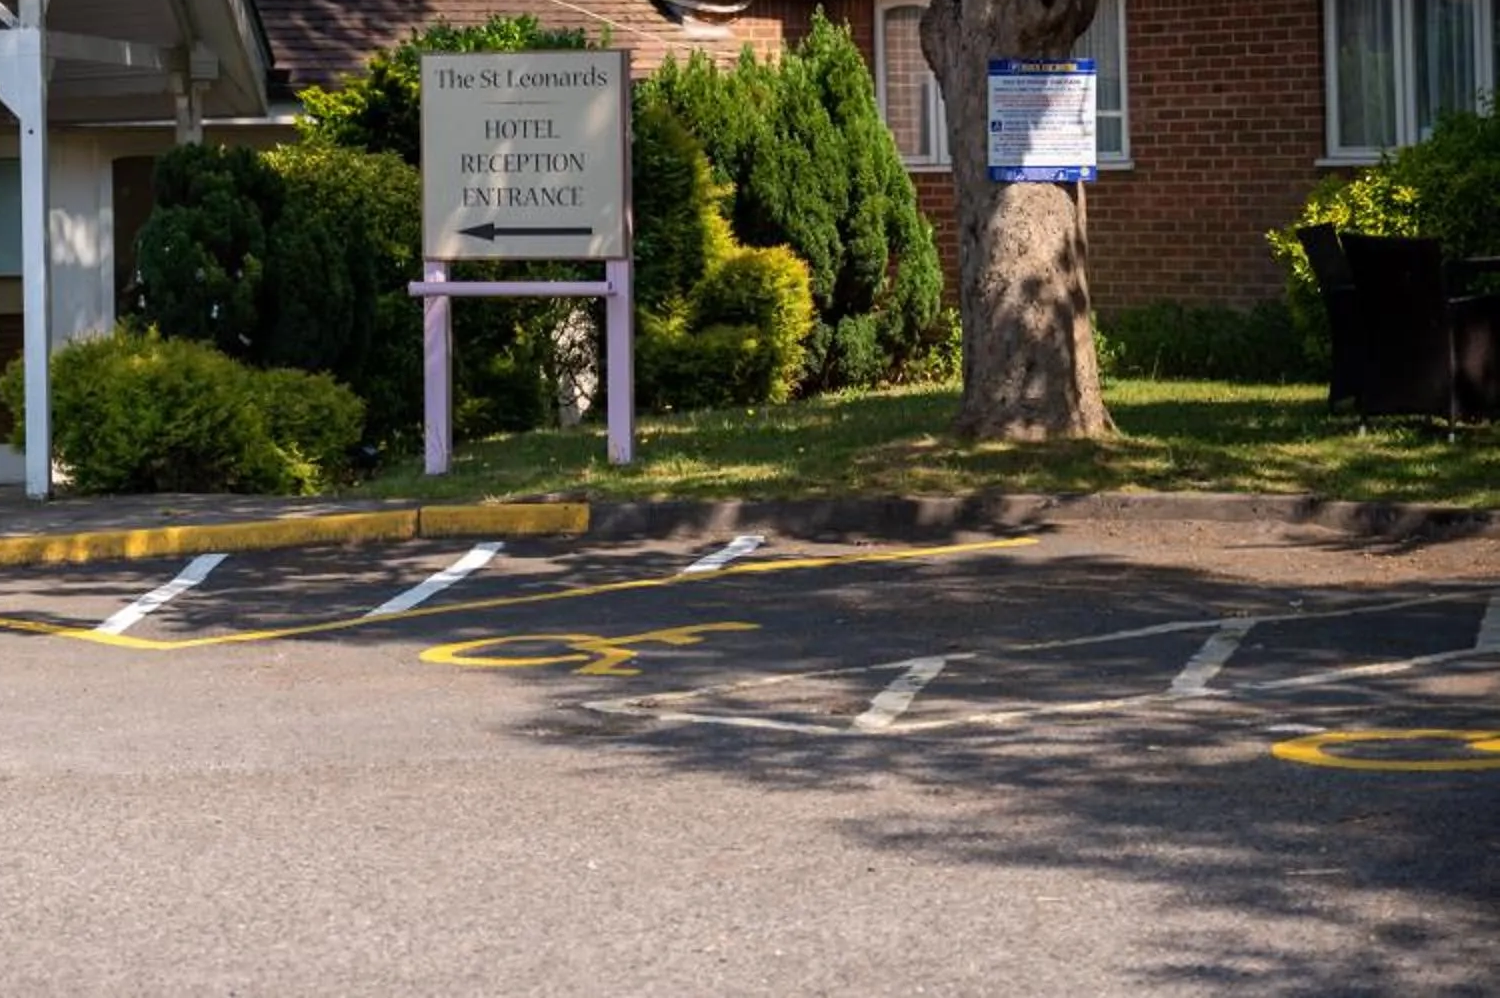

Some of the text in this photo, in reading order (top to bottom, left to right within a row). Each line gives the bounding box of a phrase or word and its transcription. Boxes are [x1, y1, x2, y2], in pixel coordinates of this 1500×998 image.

[435, 64, 609, 89] The St Leonards
[484, 119, 561, 140] HOTEL
[460, 153, 586, 174] RECEPTION
[462, 186, 584, 208] ENTRANCE
